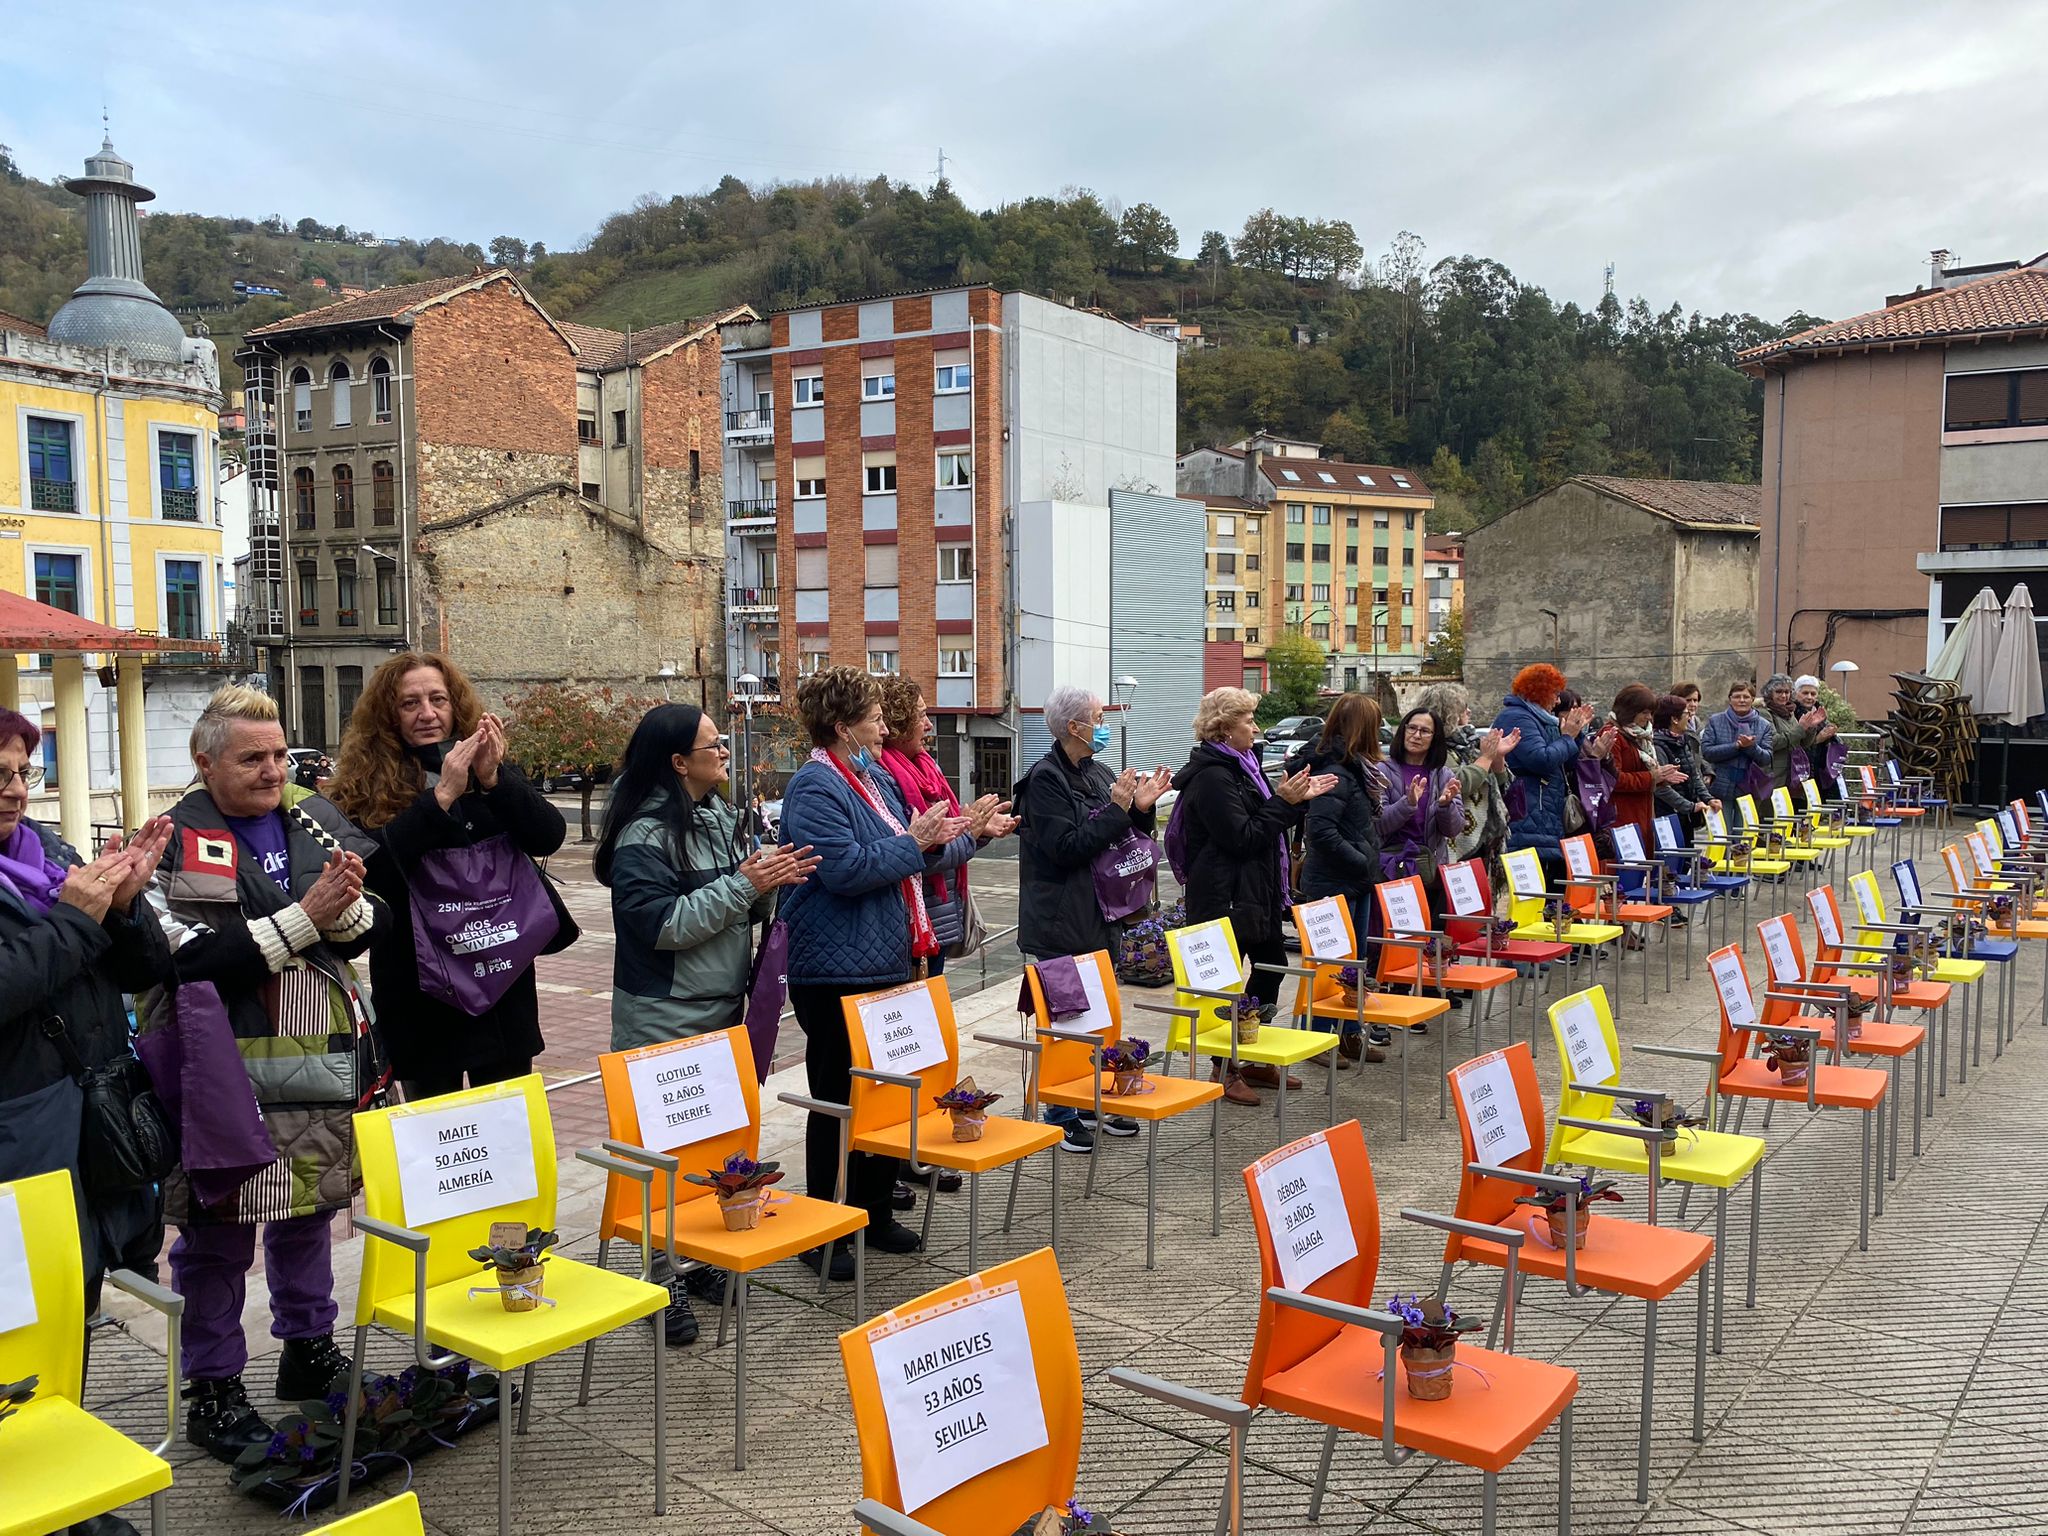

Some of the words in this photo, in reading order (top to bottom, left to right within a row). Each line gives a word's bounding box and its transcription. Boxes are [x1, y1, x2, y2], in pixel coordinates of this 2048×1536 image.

[1114, 849, 1152, 870] QUEREMOS
[1125, 847, 1142, 861] NOS
[1126, 860, 1150, 874] VIVAS
[438, 902, 462, 913] 25N
[445, 920, 518, 943] QUEREMOS
[464, 919, 492, 932] NOS
[463, 932, 506, 952] VIVAS
[489, 959, 513, 973] PSOE
[1199, 953, 1214, 964] AÑOS
[1199, 967, 1220, 979] CUENCA
[883, 1011, 902, 1023] SARA
[884, 1033, 892, 1042] 38
[892, 1025, 913, 1040] AÑOS
[886, 1041, 921, 1060] NAVARRA
[1575, 1038, 1588, 1051] AÑOS
[656, 1063, 702, 1084] CLOTILDE
[662, 1092, 674, 1104] 82
[676, 1084, 705, 1101] AÑOS
[1477, 1083, 1493, 1098] LUISA
[665, 1103, 712, 1125] TENERIFE
[1481, 1104, 1498, 1120] AÑOS
[438, 1123, 479, 1142] MAITE
[435, 1154, 450, 1168] 50
[453, 1146, 489, 1165] AÑOS
[438, 1168, 494, 1193] ALMERÍA
[1276, 1176, 1308, 1203] DÉBORA
[1284, 1215, 1294, 1230] 39
[1293, 1202, 1316, 1226] AÑOS
[1291, 1230, 1324, 1258] MÁLAGA
[903, 1350, 940, 1381] MARI
[942, 1331, 993, 1363] NIEVES
[923, 1390, 941, 1413] 53
[943, 1373, 984, 1405] AÑOS
[934, 1411, 988, 1449] SEVILLA
